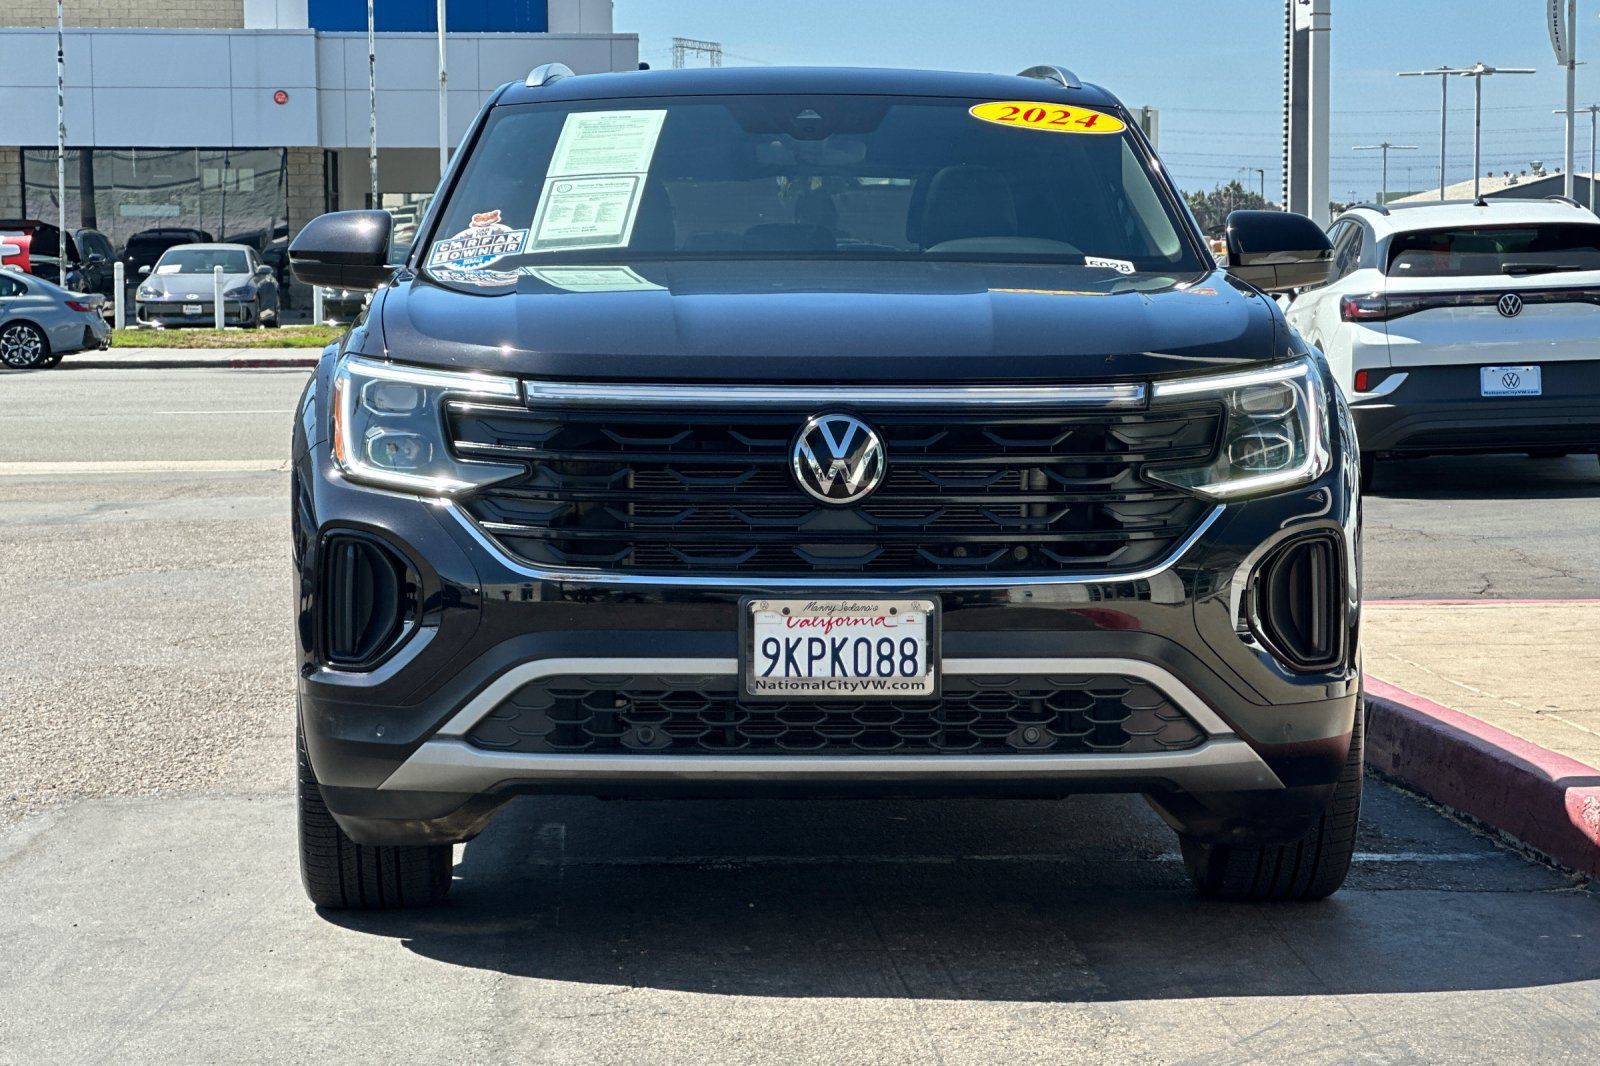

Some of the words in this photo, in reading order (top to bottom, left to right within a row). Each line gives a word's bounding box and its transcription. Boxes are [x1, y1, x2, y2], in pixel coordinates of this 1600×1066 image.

[996, 106, 1100, 128] 2024
[440, 234, 521, 251] CARFAX
[794, 414, 883, 504] VW
[803, 601, 836, 616] Manny
[786, 615, 898, 635] California
[761, 637, 919, 678] 9KPK088
[755, 680, 926, 692] NationalCityVW.com
